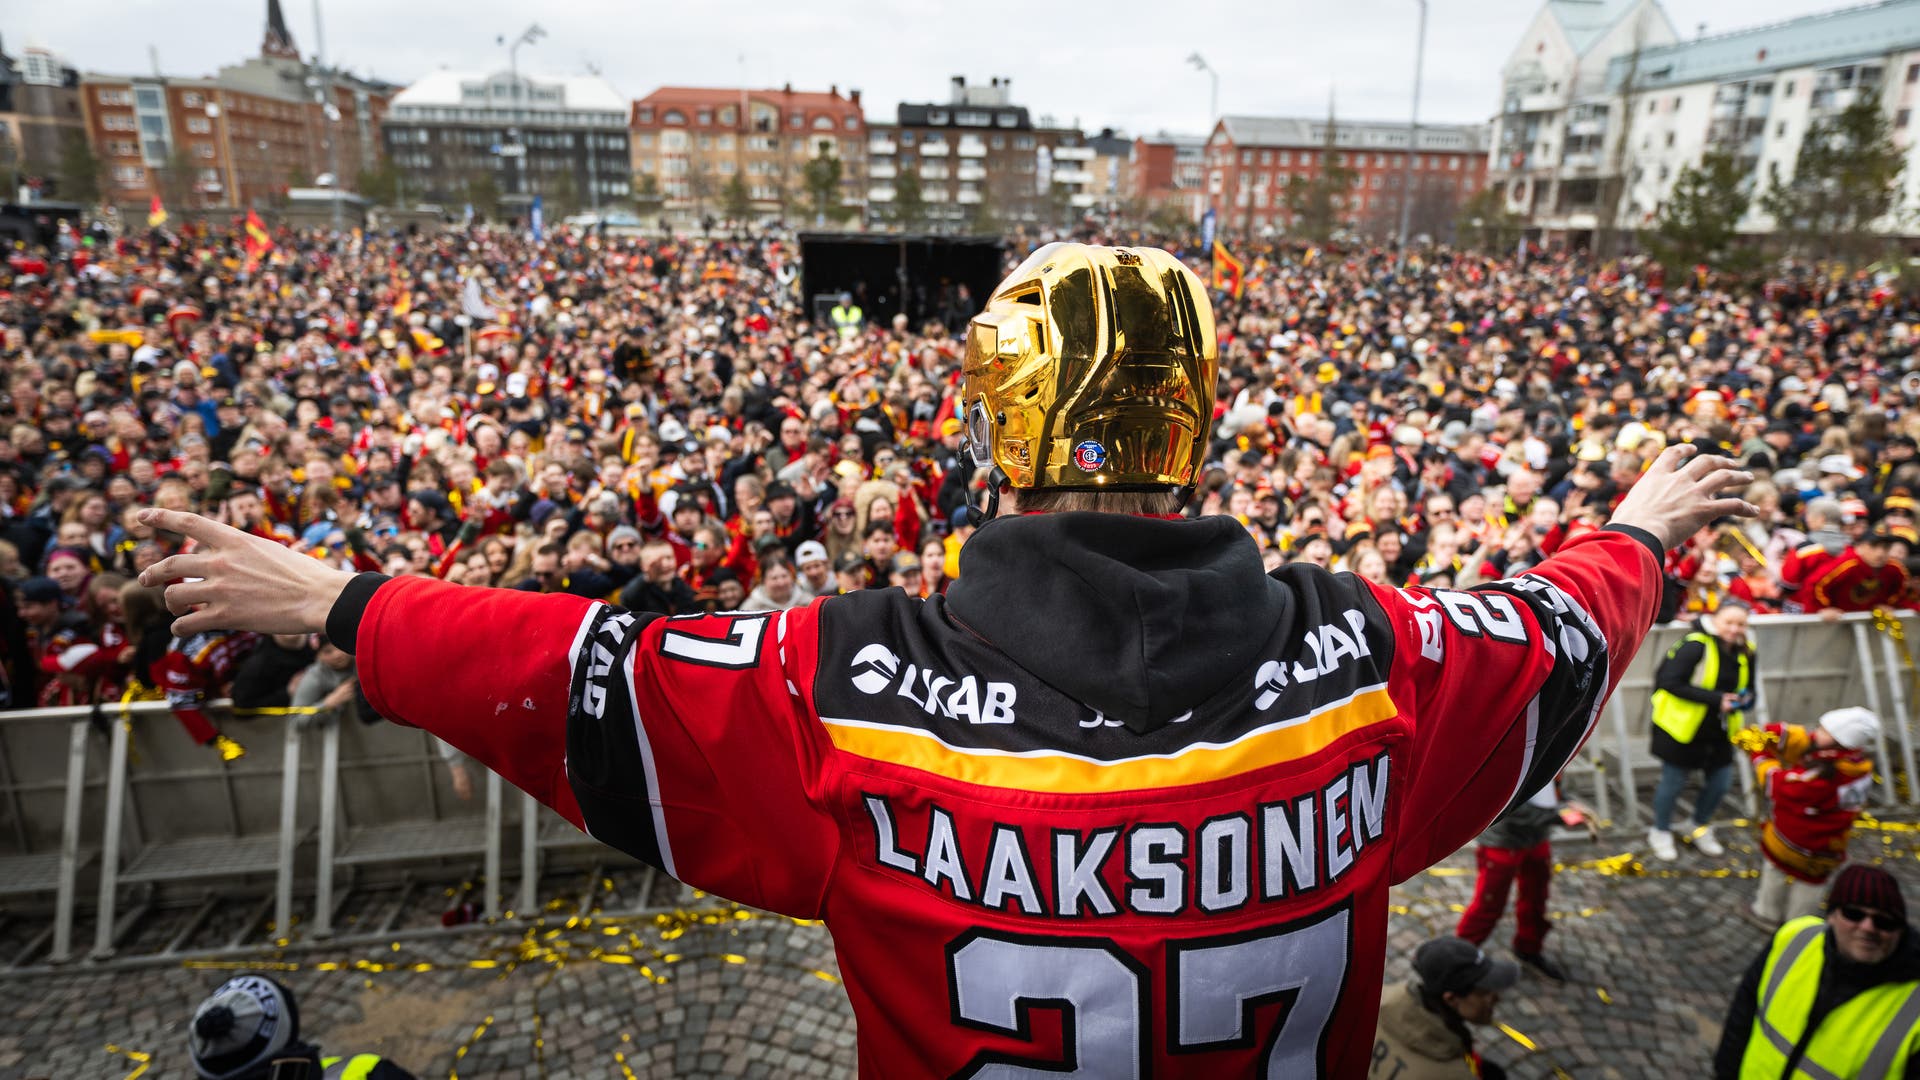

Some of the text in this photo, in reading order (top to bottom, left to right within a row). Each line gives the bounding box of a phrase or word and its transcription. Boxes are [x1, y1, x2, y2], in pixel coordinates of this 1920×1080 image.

[582, 611, 637, 720] KAB
[658, 609, 782, 671] 7
[897, 663, 1017, 725] LKAB
[863, 750, 1390, 917] LAAKSONEN
[944, 908, 1355, 1080] 27
